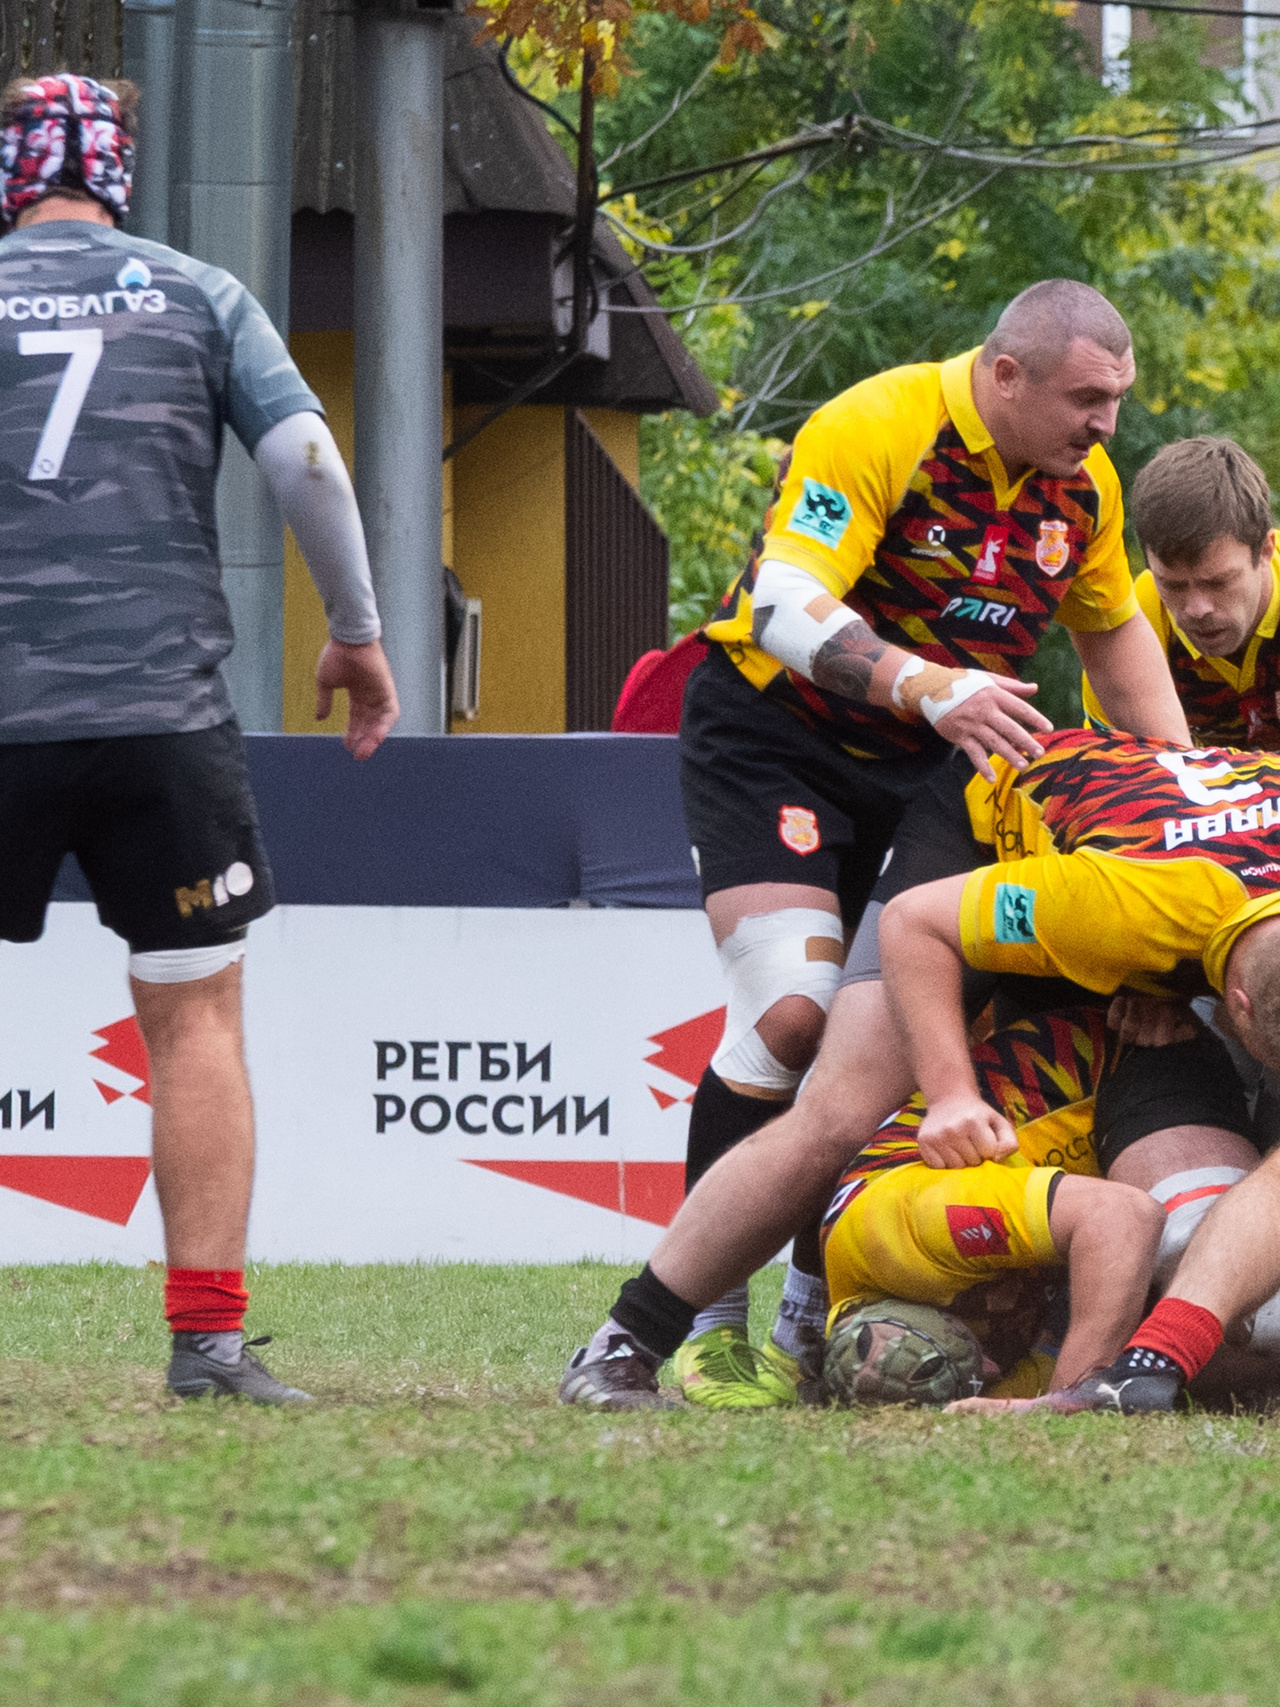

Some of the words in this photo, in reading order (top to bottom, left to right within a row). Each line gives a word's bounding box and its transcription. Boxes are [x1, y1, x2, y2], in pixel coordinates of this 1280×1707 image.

[0, 289, 167, 320] СОБЛГАЗ
[18, 328, 103, 480] 7
[940, 597, 1016, 627] PARI
[373, 1040, 552, 1082] РЕГБИ
[373, 1094, 609, 1136] РОССИИ
